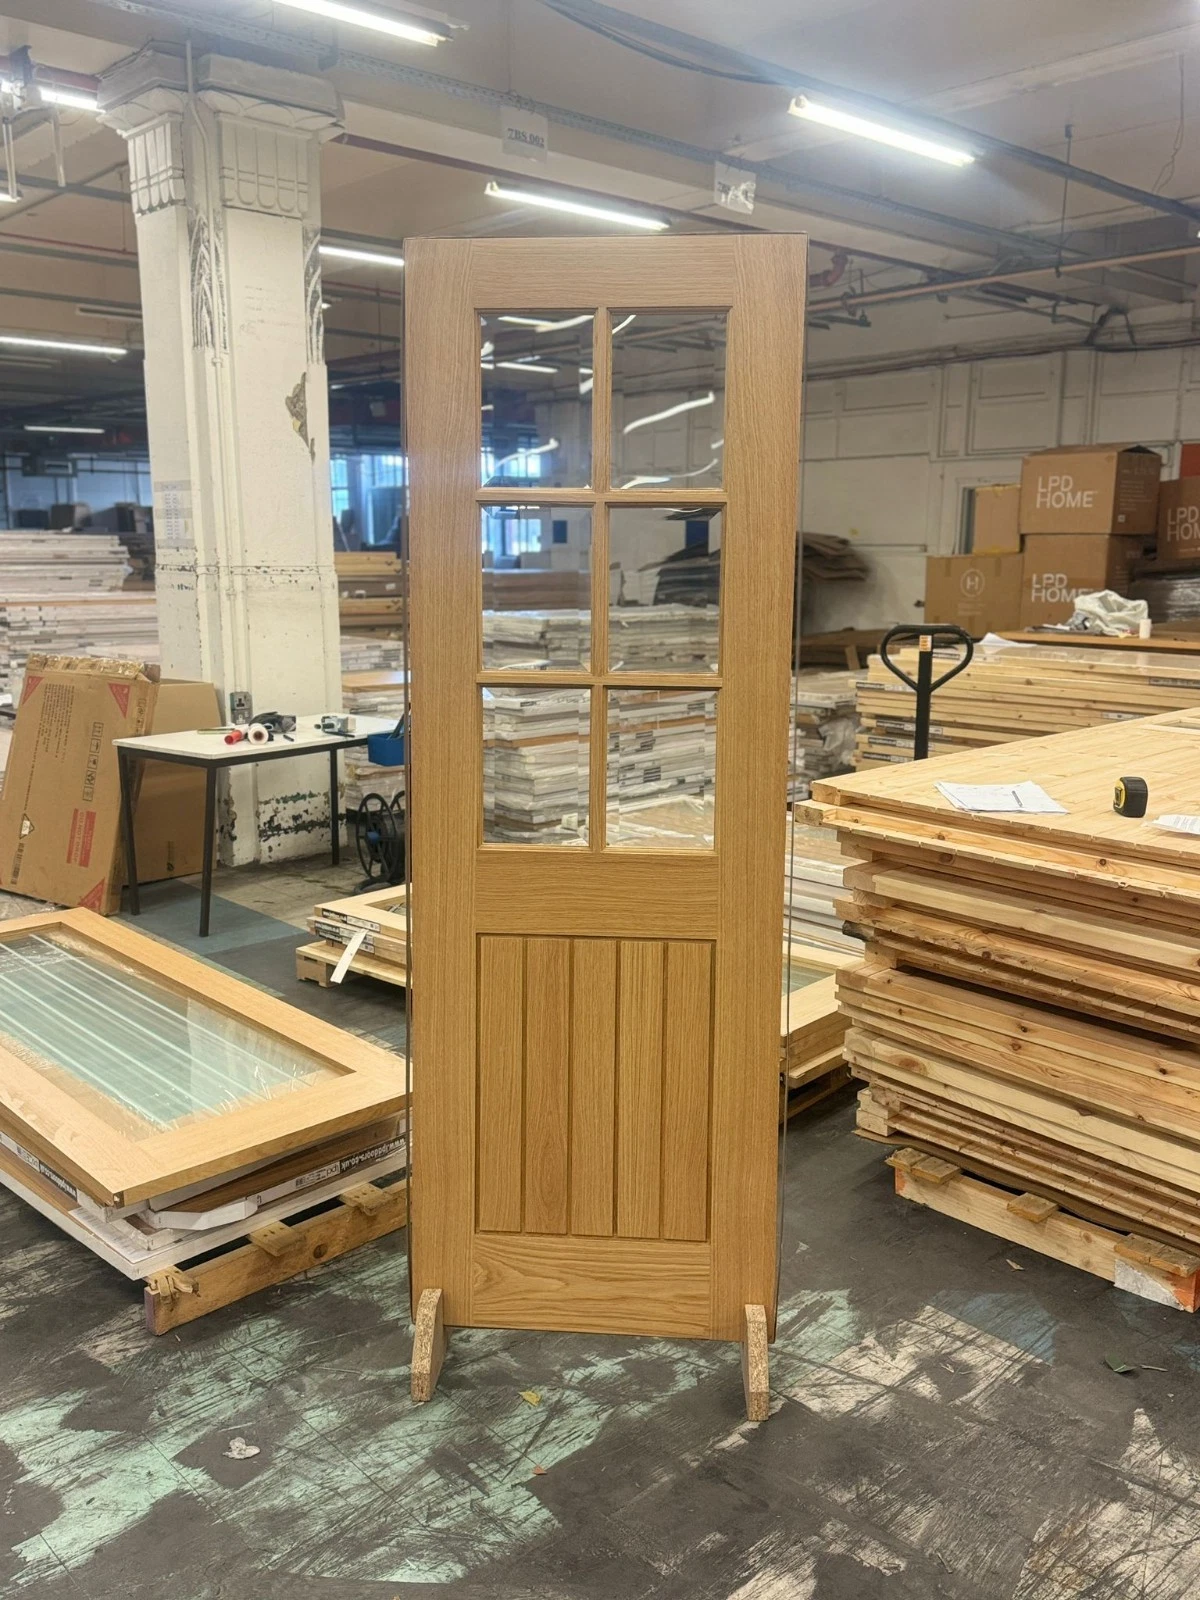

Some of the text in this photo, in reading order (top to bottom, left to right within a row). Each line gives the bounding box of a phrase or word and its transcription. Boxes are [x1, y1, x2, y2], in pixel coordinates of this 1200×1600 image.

[1038, 475, 1073, 492] LPD
[1036, 490, 1093, 509] HOME
[1167, 505, 1199, 525] LPD
[1032, 573, 1068, 588] LPD
